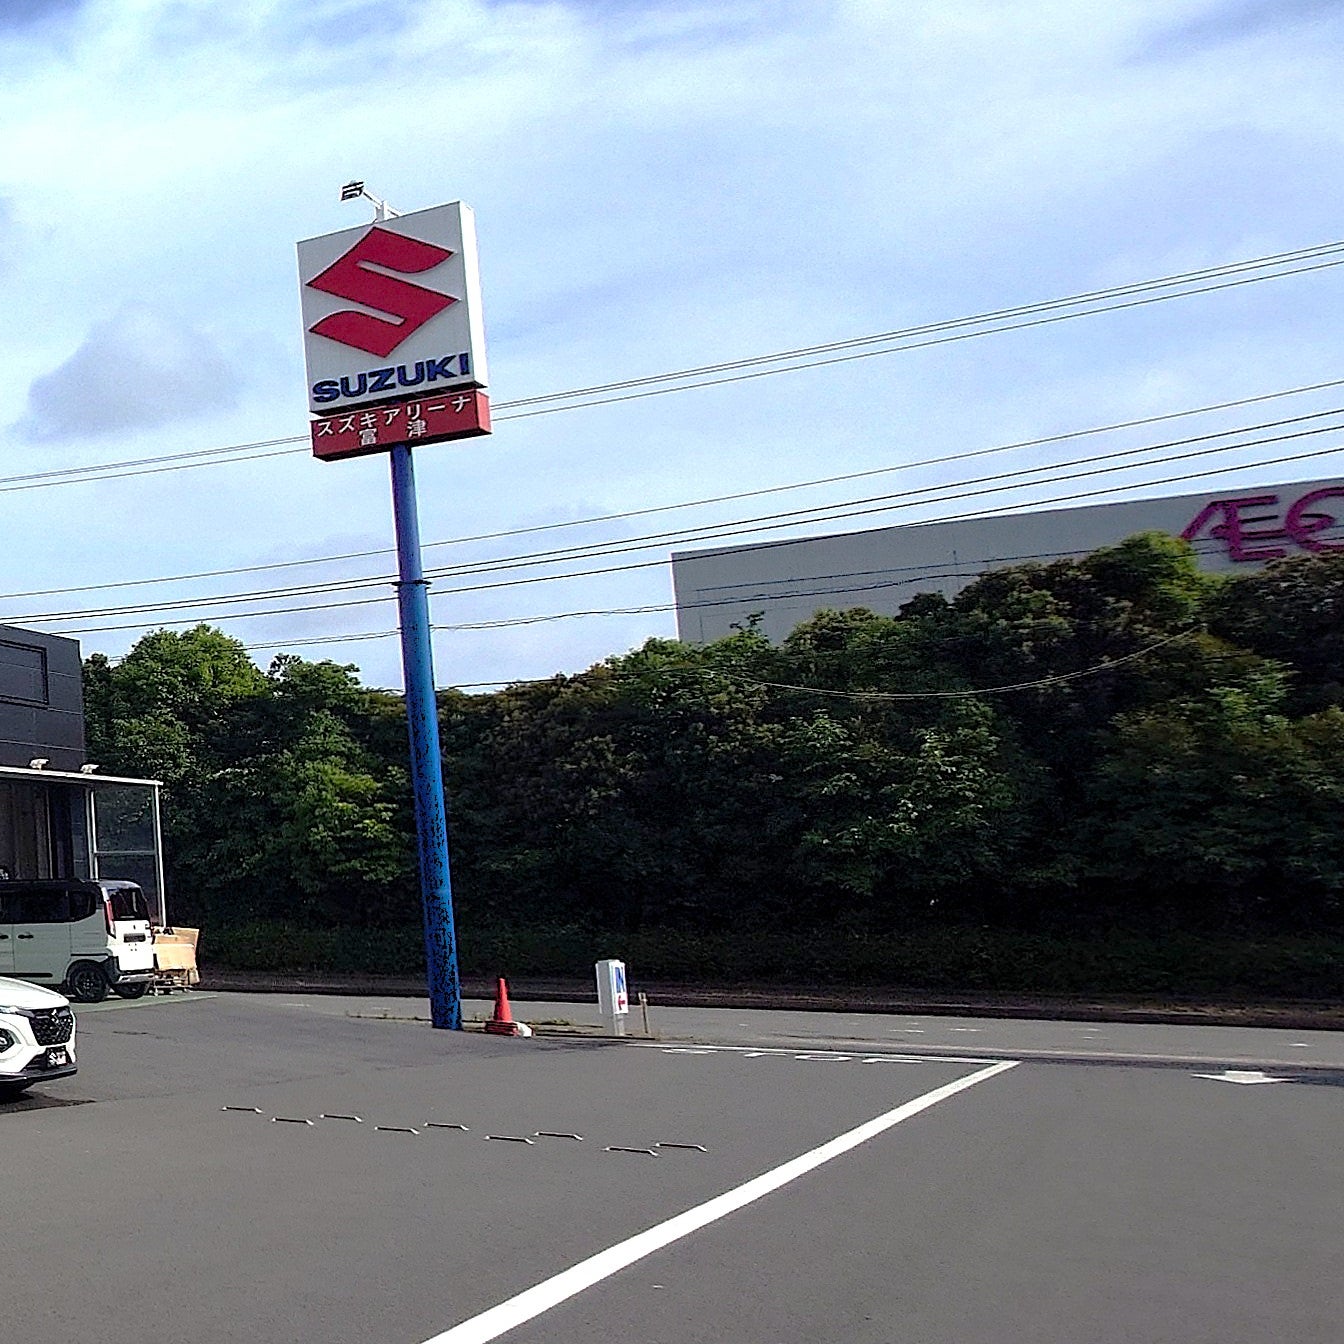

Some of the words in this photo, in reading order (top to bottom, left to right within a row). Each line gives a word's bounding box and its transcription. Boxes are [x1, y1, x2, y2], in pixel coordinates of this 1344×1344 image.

[312, 353, 471, 403] SUZUKI
[318, 396, 472, 437] スズキアリーナ
